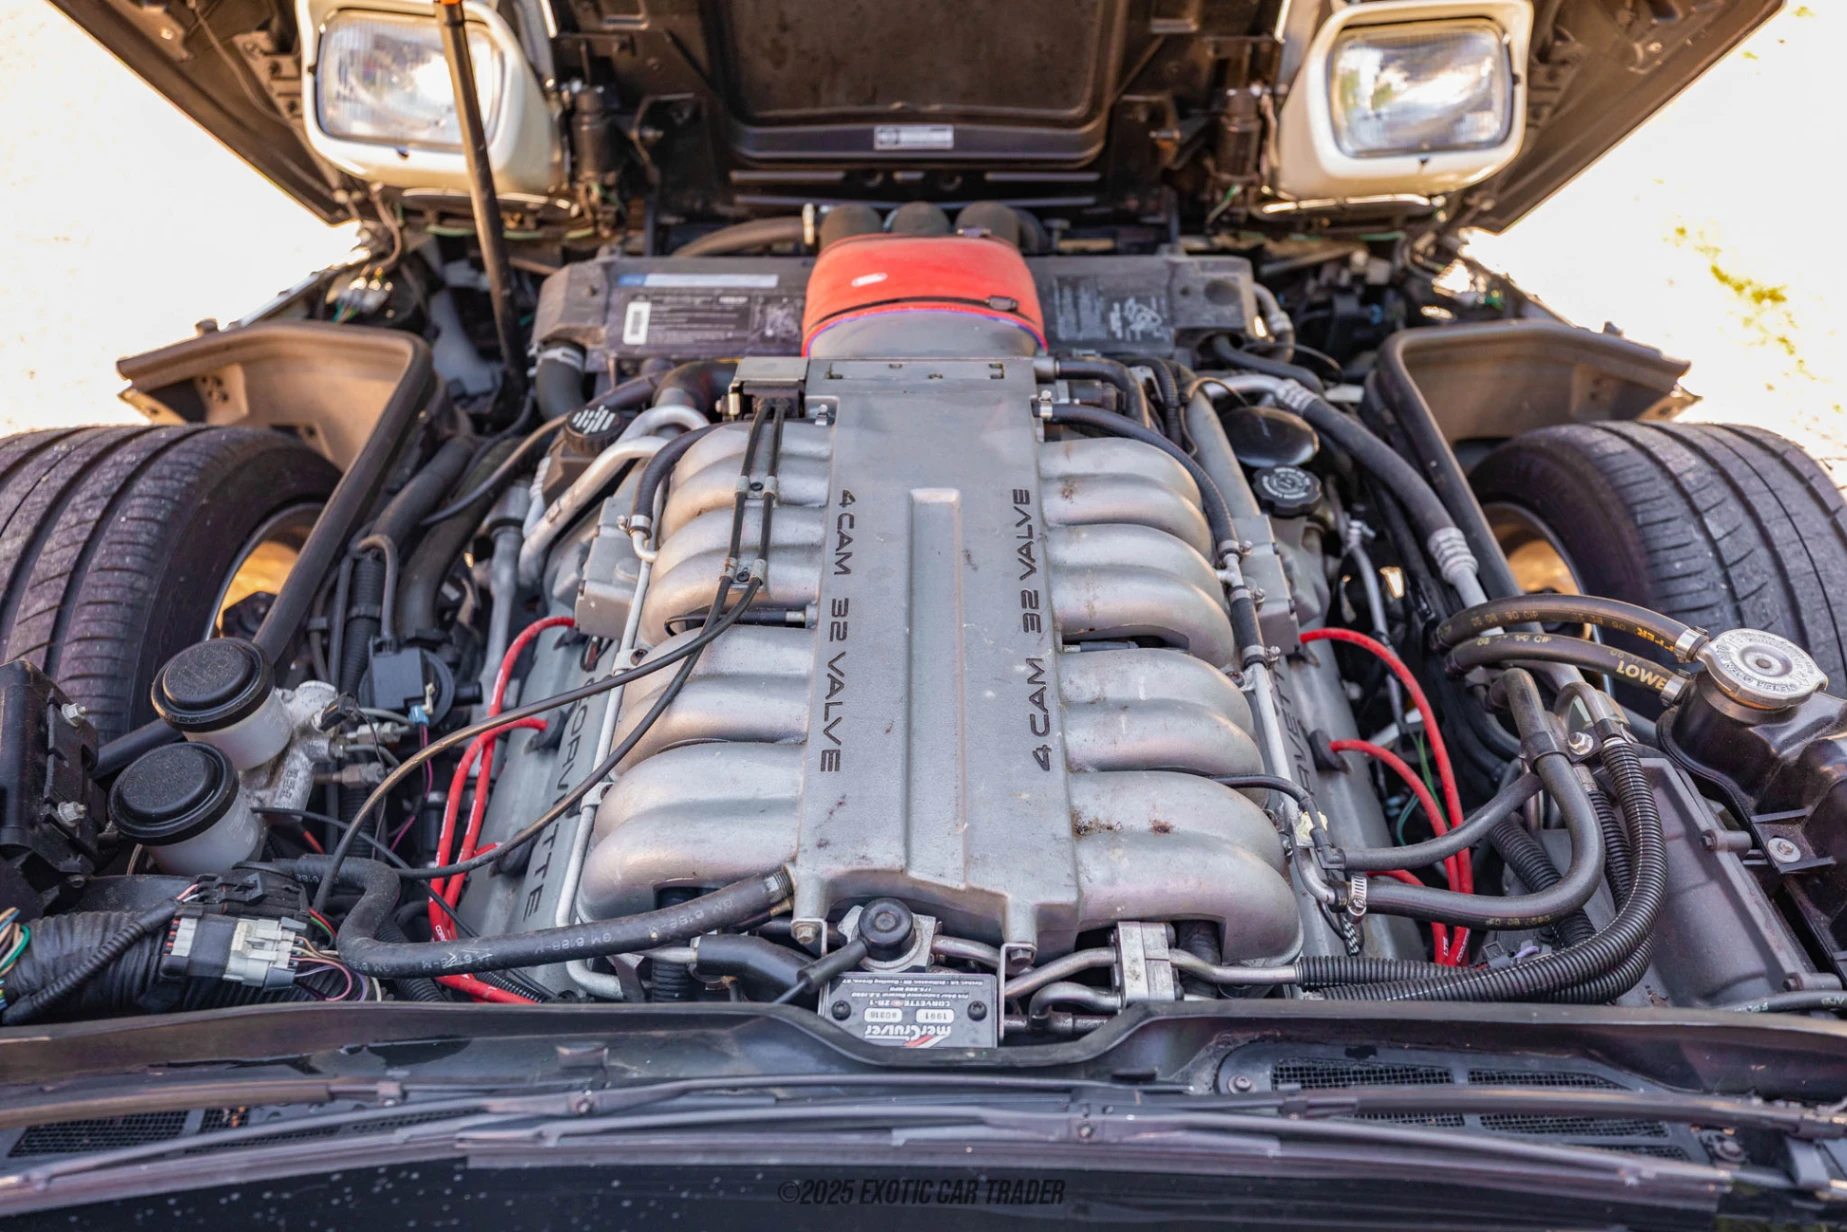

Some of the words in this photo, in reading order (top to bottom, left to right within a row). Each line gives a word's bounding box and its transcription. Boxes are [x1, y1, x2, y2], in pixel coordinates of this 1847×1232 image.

[1012, 488, 1038, 581] VALVE
[829, 597, 849, 643] 32
[1020, 589, 1042, 634] 32
[1616, 660, 1668, 691] LOWE
[820, 651, 846, 773] VALVE
